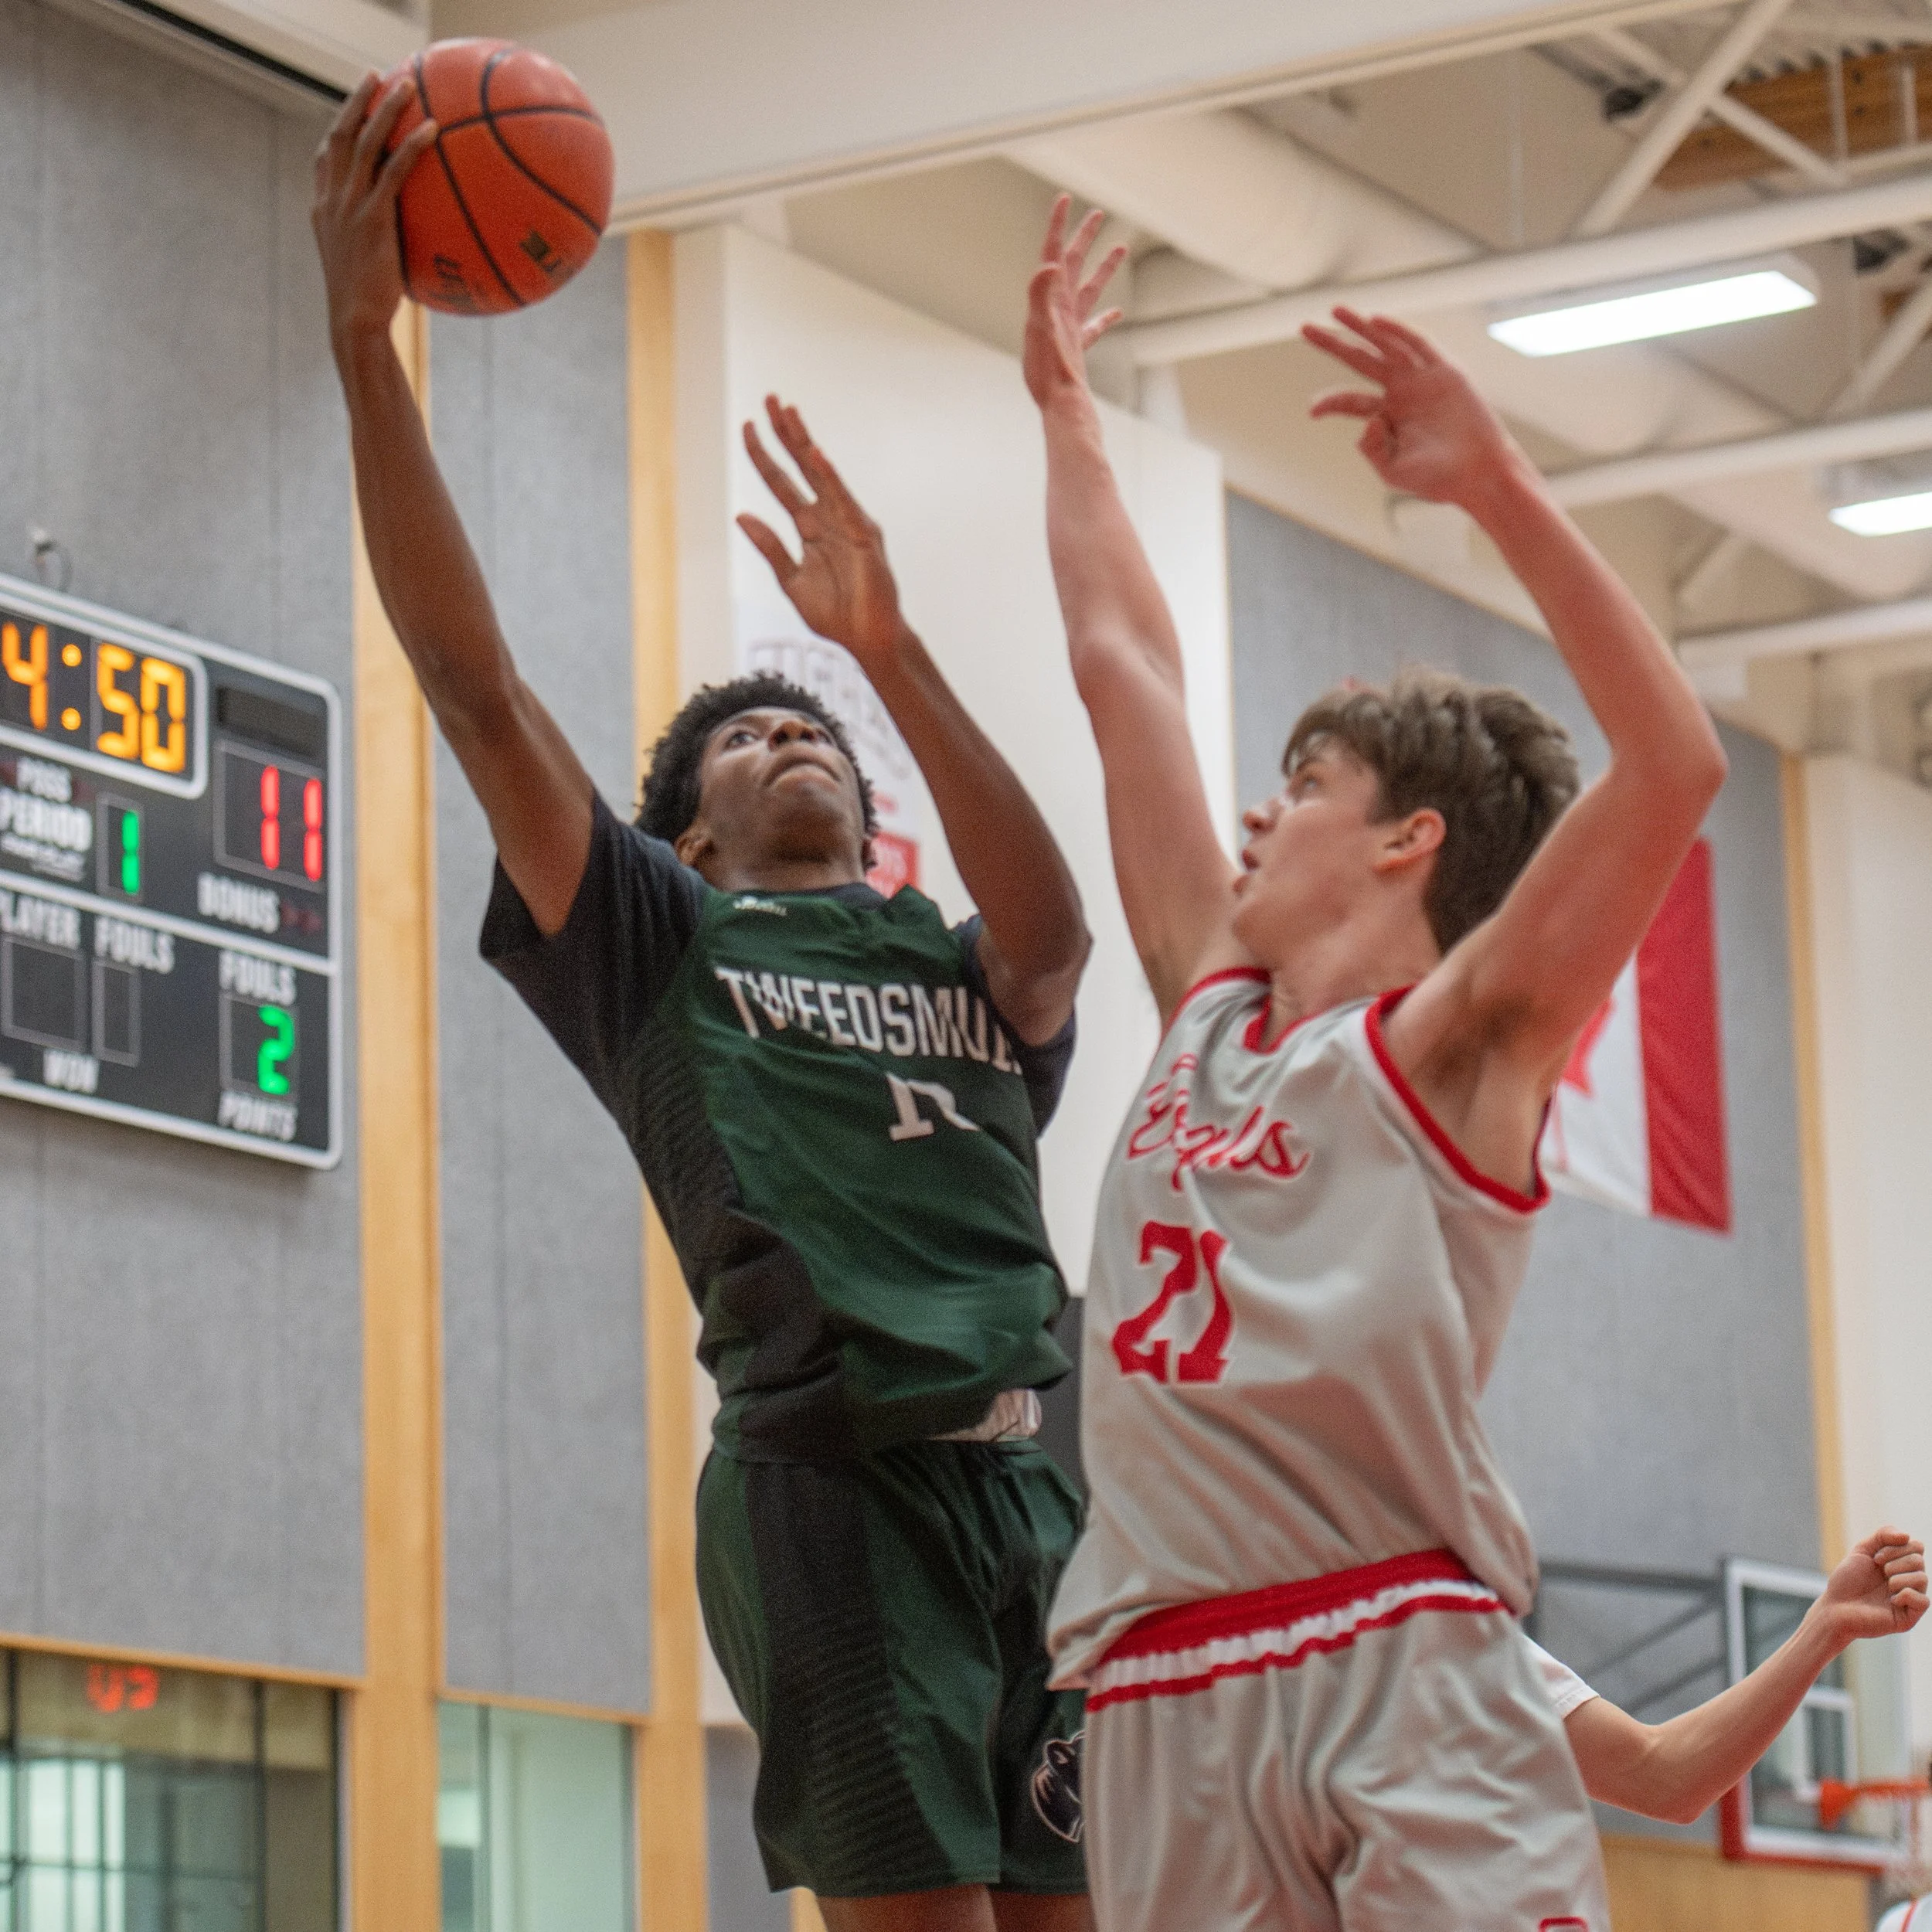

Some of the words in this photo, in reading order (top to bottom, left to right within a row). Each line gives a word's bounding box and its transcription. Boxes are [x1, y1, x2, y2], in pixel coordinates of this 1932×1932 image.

[2, 622, 186, 774] 4:50
[121, 809, 140, 896] 1
[260, 764, 323, 882] 11
[94, 913, 175, 975] FOULS
[198, 872, 281, 934] BONUS
[219, 949, 297, 1005] FOULS
[257, 1005, 294, 1095] 2
[218, 1091, 298, 1143] POINTS
[1111, 1219, 1233, 1383] 21
